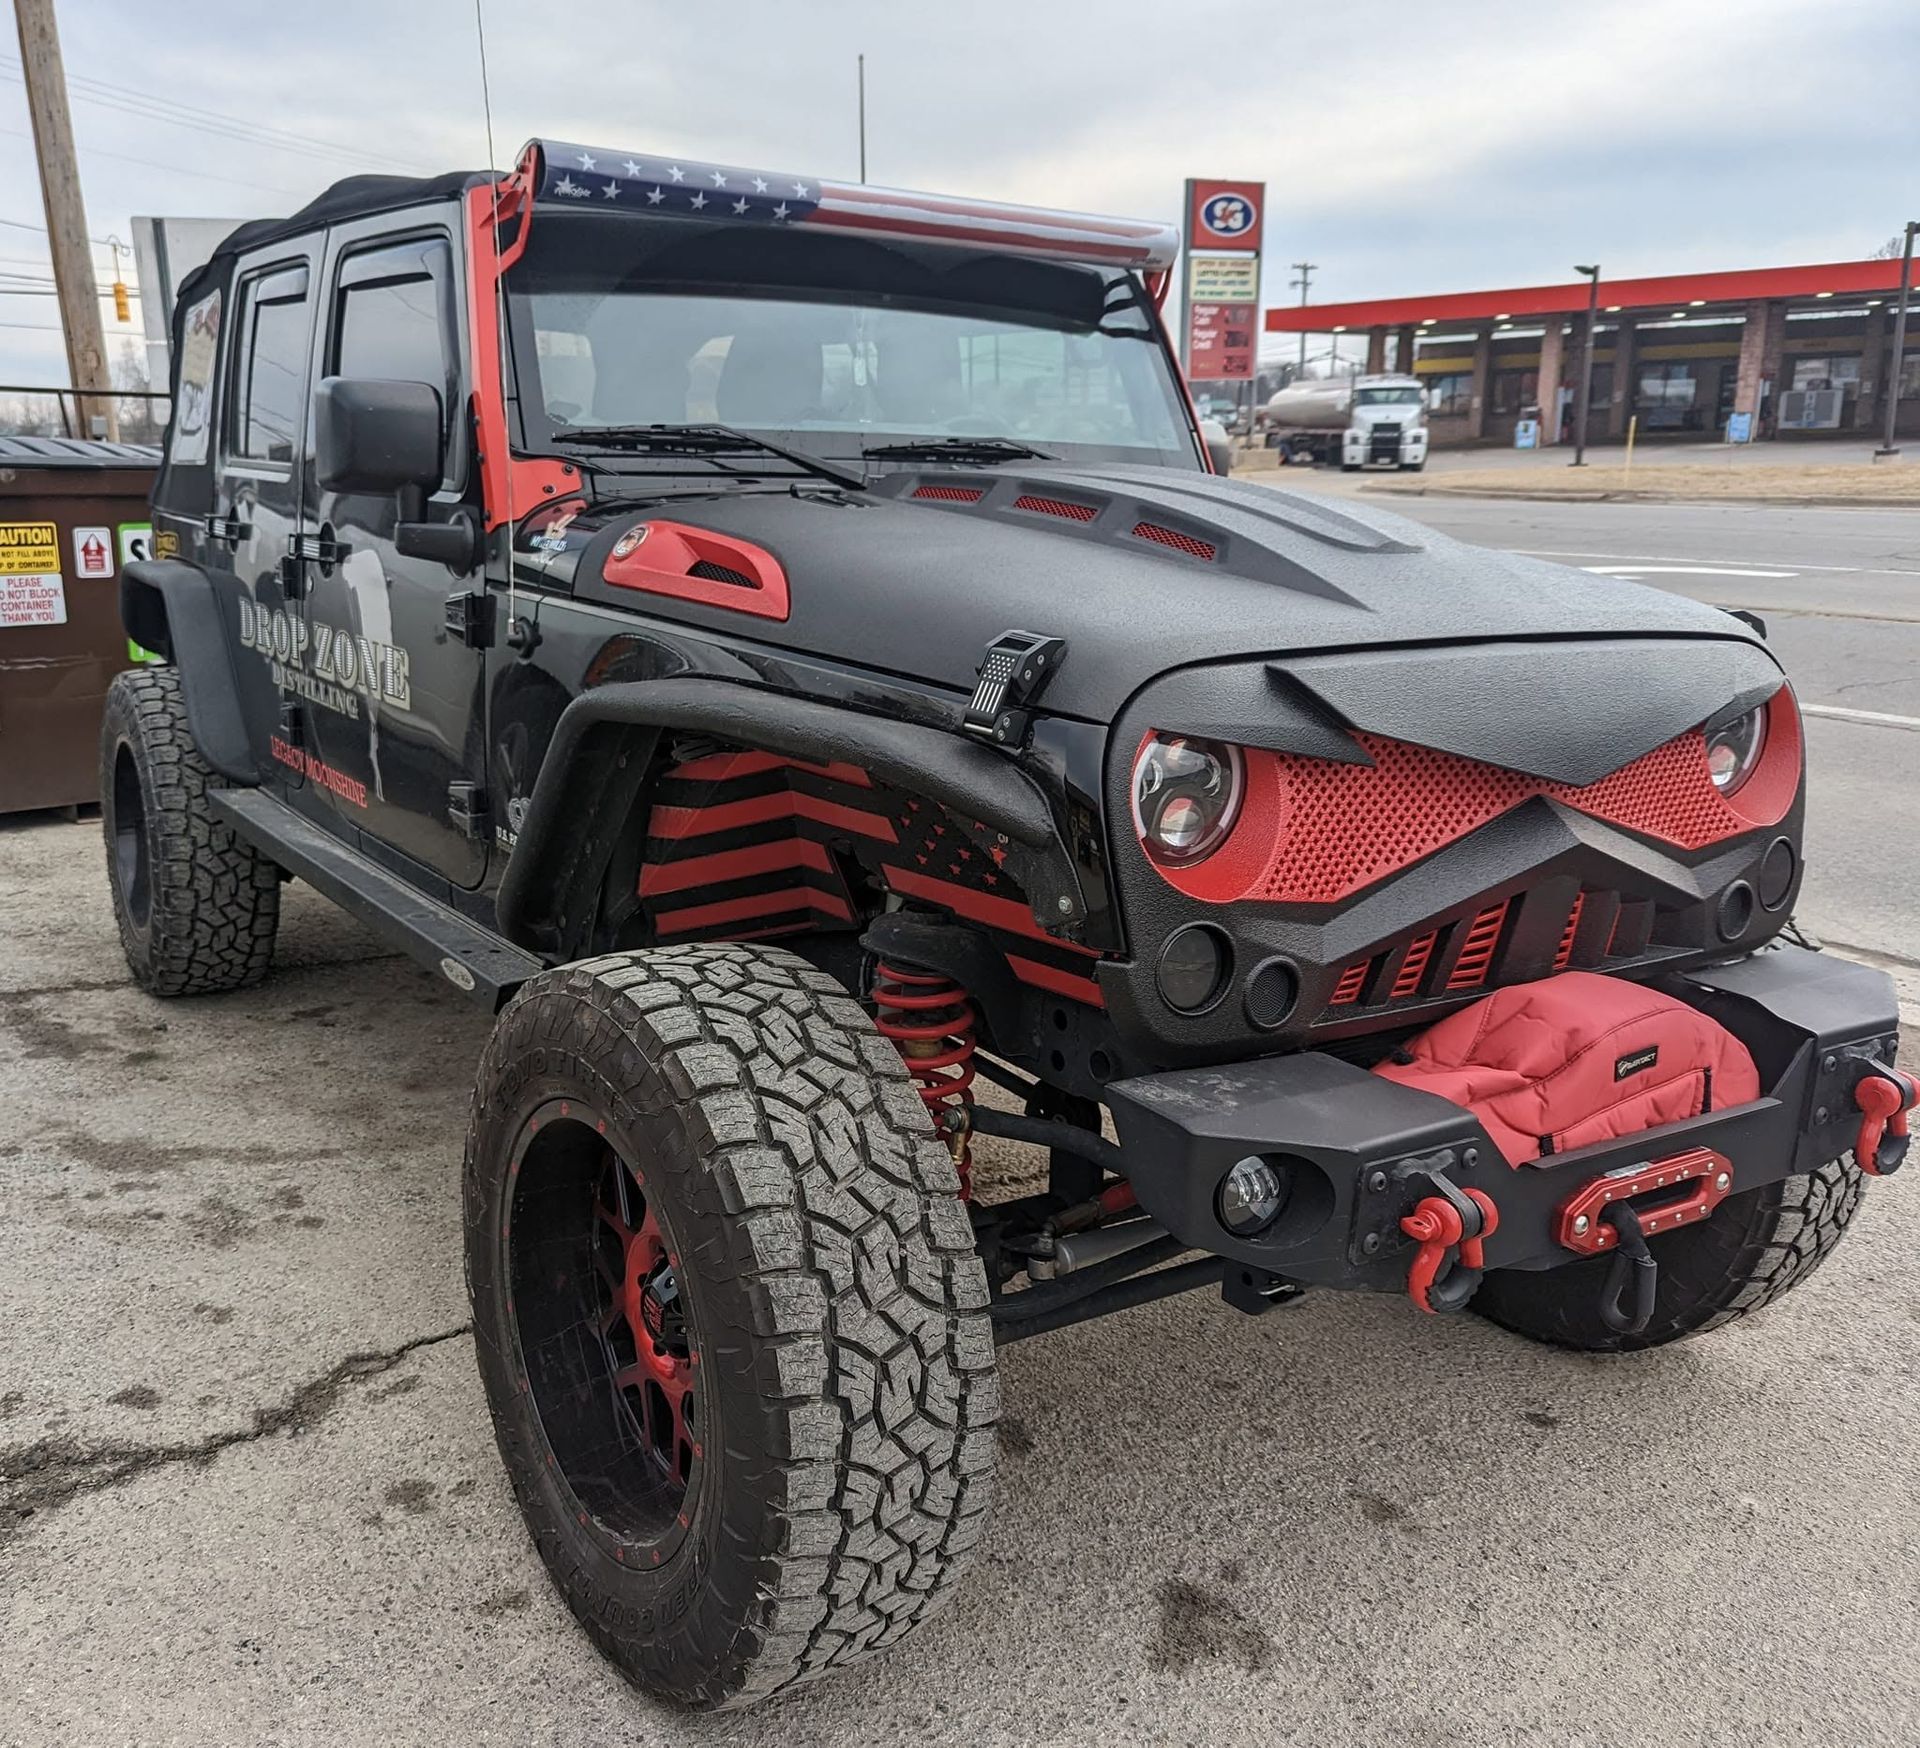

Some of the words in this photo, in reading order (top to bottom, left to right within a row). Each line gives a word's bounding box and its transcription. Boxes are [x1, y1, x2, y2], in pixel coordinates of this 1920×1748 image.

[0, 527, 53, 545] AUTION
[18, 561, 54, 569] CONTAINER
[7, 577, 43, 588] PLEASE
[8, 589, 27, 600] NOT
[30, 588, 60, 598] BLOCK
[1, 600, 54, 612] CONTAINER
[2, 612, 34, 623] THANK
[36, 611, 56, 621] YOU
[239, 596, 309, 669] DROP
[313, 621, 411, 711] ZONE
[271, 661, 360, 720] DISTILLING
[304, 754, 368, 809] MOONSHINE
